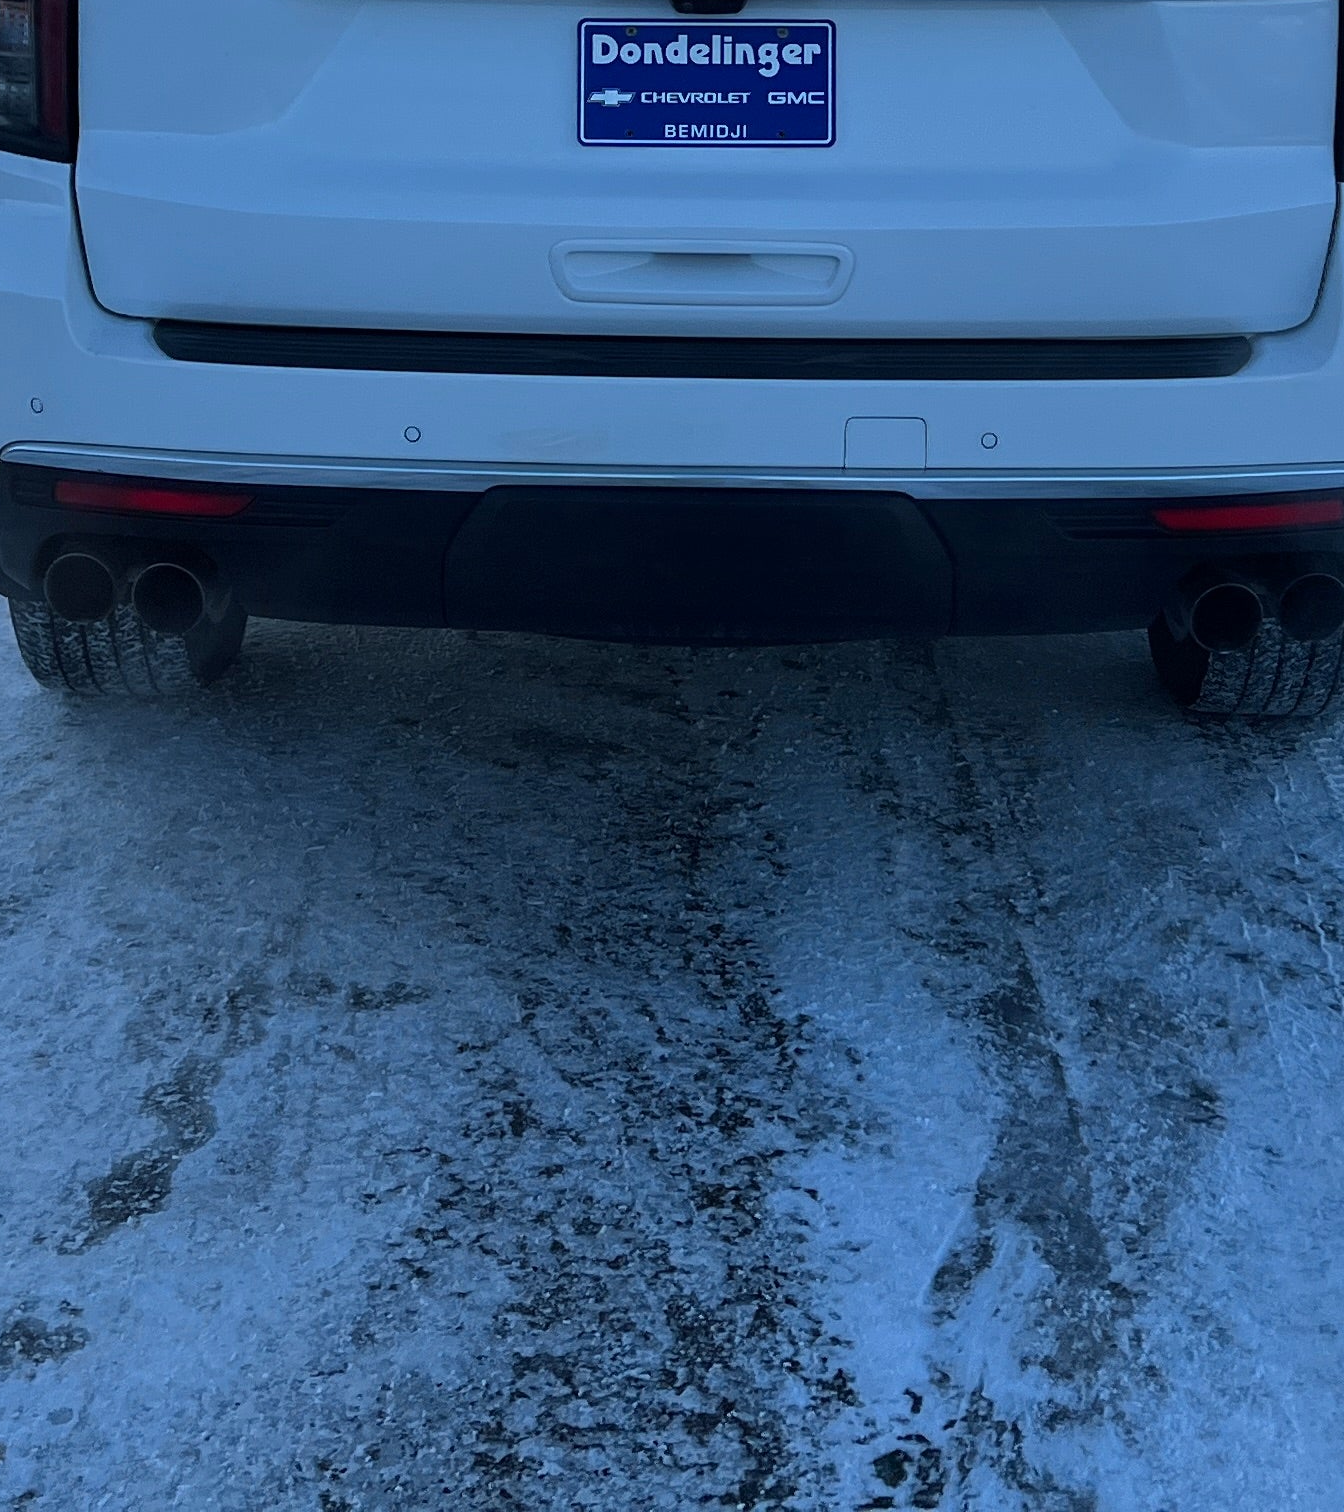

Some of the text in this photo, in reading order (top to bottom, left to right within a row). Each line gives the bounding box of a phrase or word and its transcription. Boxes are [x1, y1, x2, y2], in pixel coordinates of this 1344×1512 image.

[591, 34, 821, 78] Dondelinger
[640, 91, 825, 105] CHEVROLET GMC
[664, 124, 748, 139] BEMIDJI
